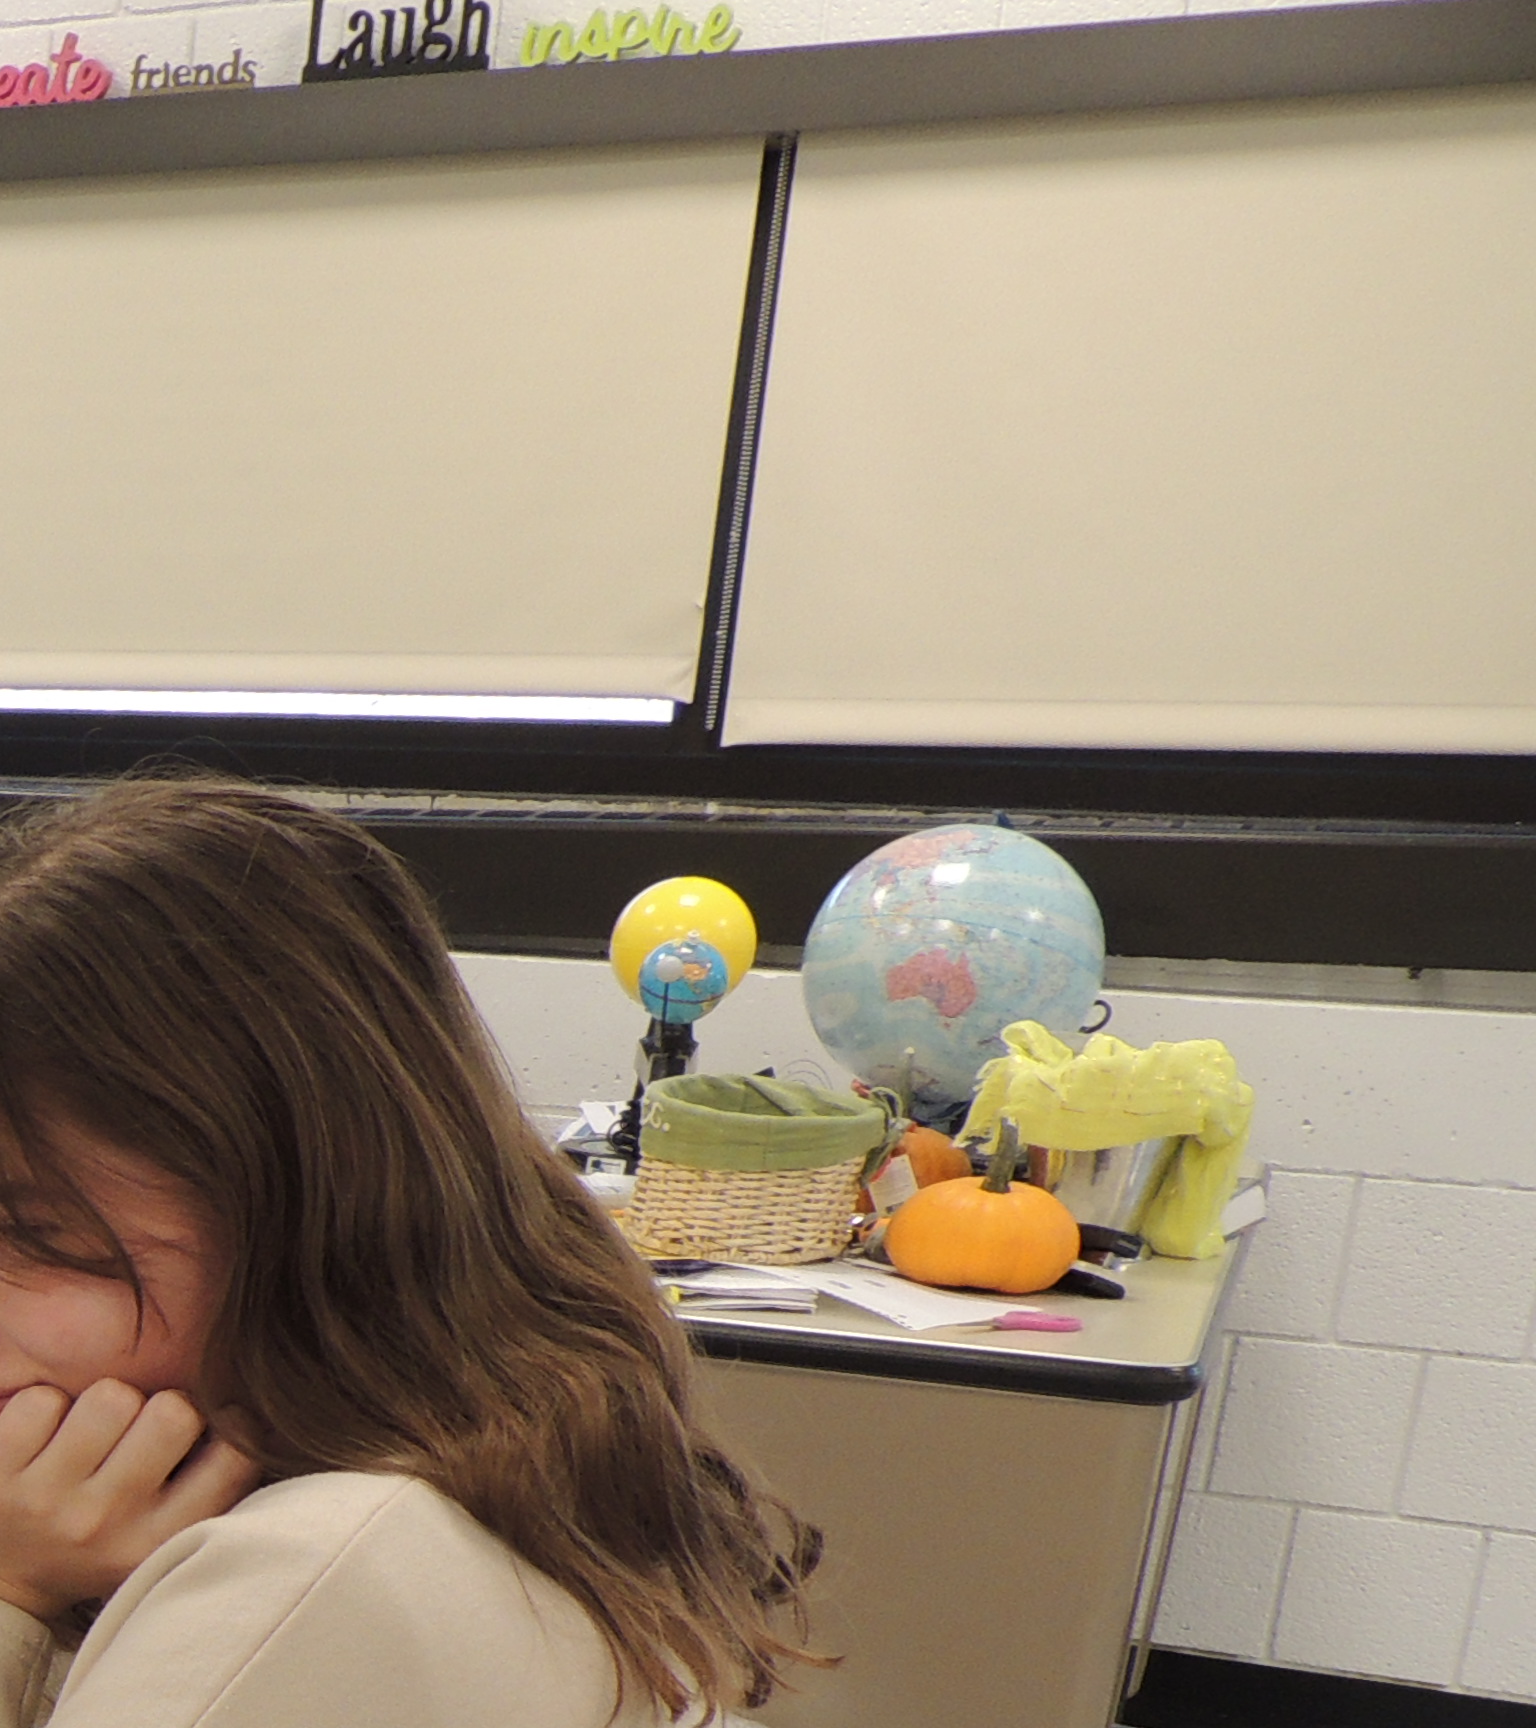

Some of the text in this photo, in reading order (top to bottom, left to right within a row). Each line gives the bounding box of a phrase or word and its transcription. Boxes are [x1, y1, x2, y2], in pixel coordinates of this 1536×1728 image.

[302, 0, 490, 83] Laugh
[519, 3, 743, 69] inspire
[130, 49, 257, 95] friends
